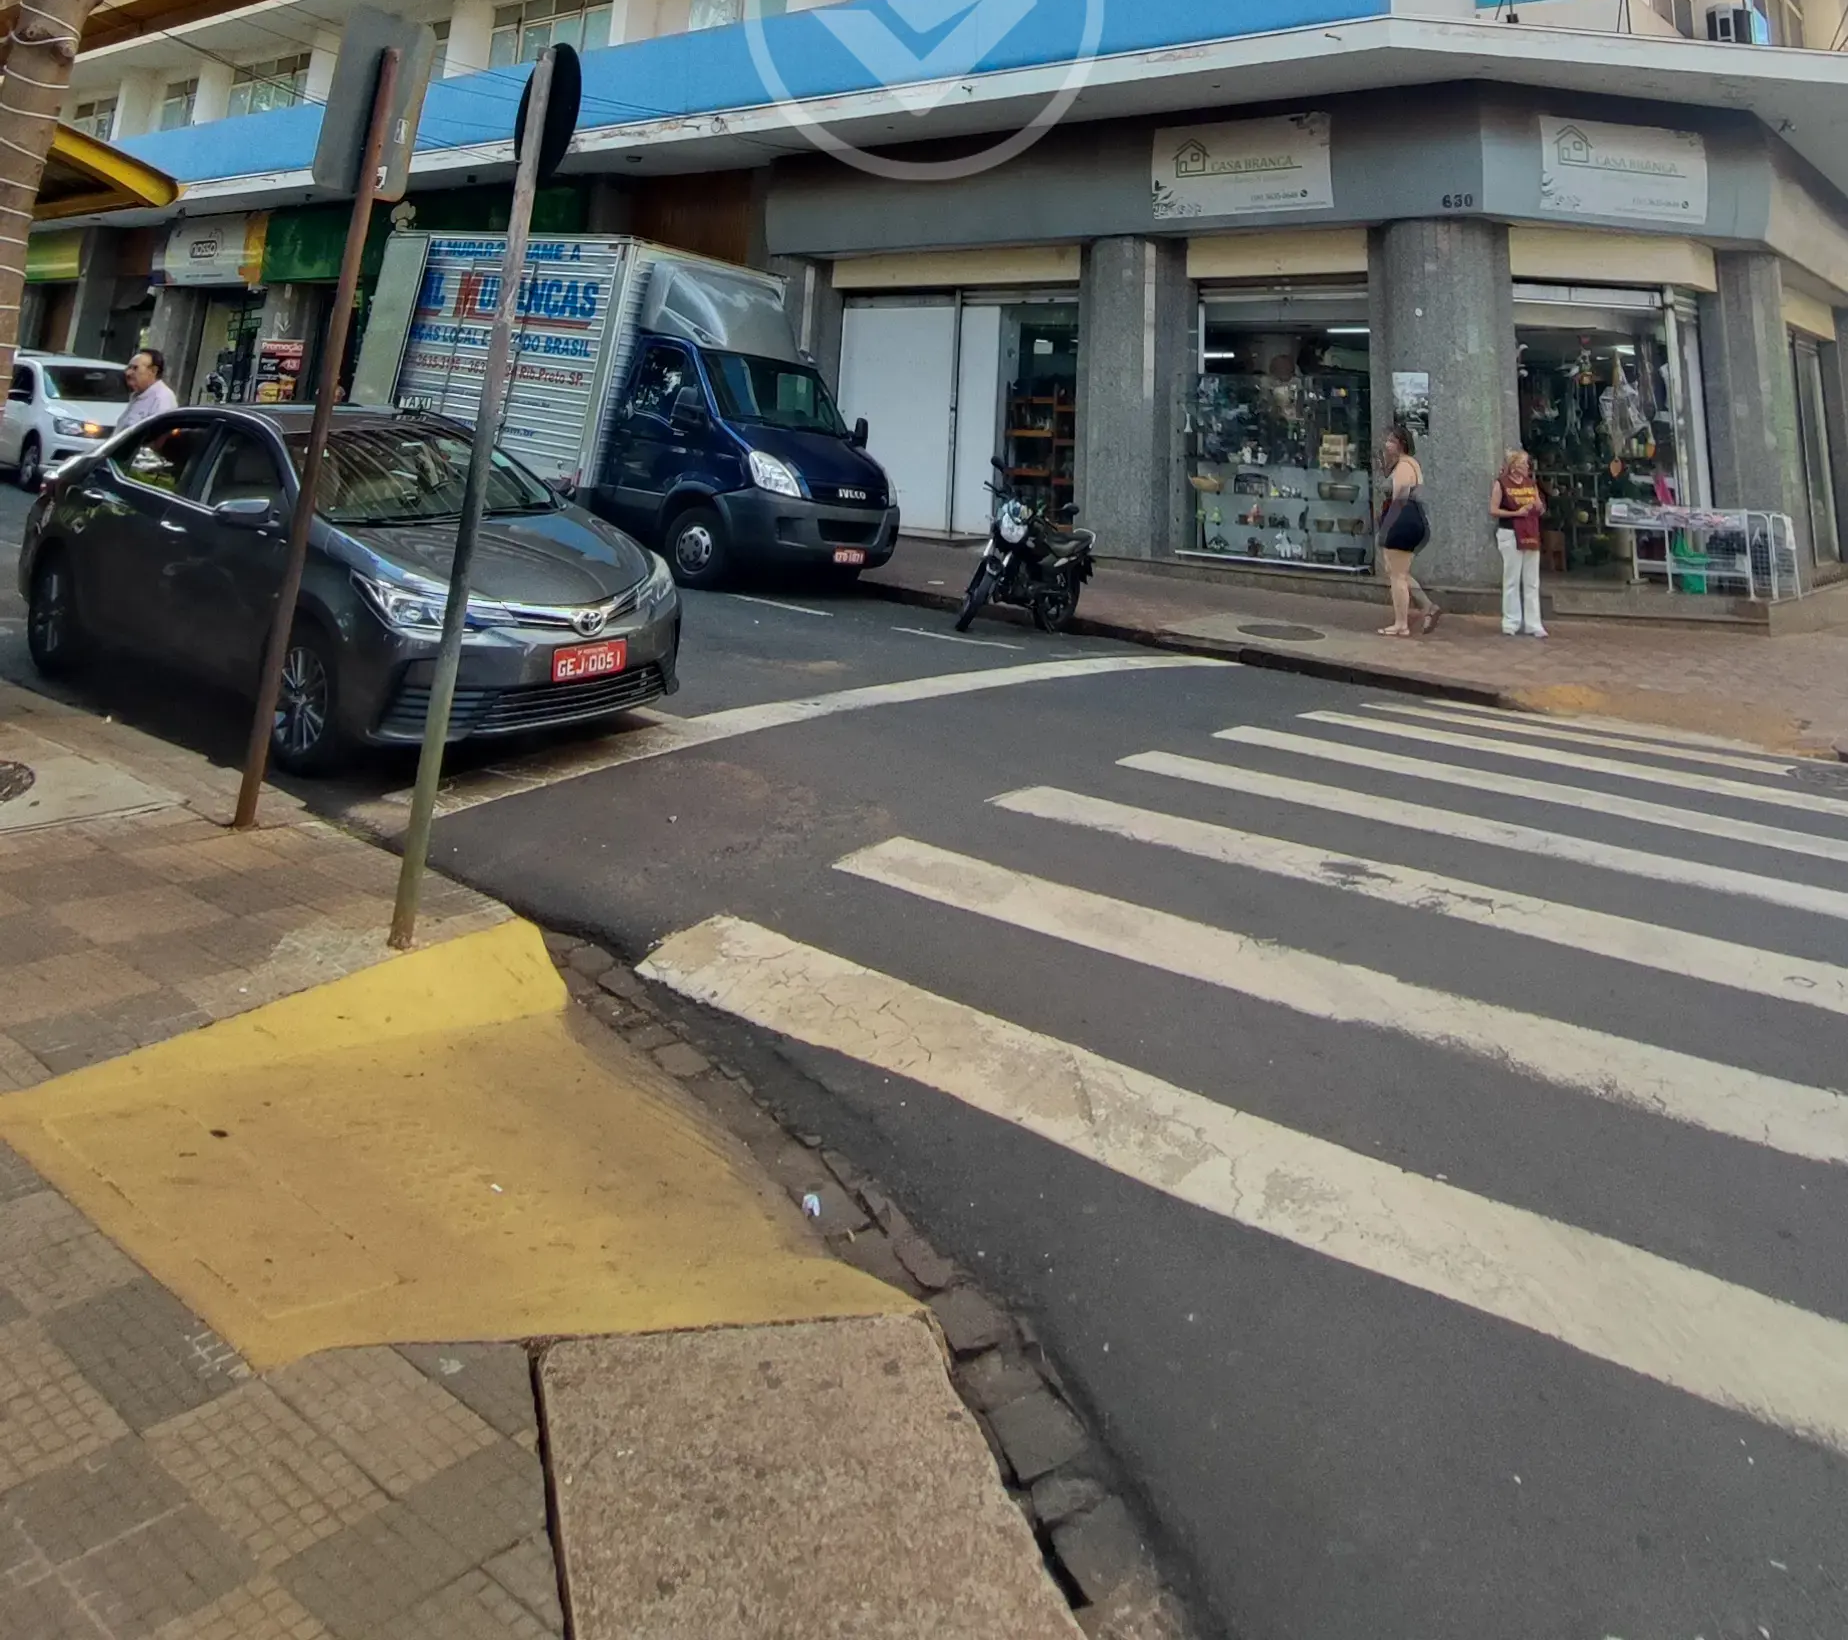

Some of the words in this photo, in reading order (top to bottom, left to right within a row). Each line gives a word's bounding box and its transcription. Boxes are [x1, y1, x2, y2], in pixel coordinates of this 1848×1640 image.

[1211, 159, 1242, 172] CASA
[1244, 155, 1294, 170] BRANCA
[1595, 156, 1627, 170] CASA
[1628, 159, 1678, 174] BRANCA
[526, 243, 565, 260] AME
[569, 244, 581, 261] A
[453, 271, 600, 318] MUNÇAS
[261, 342, 303, 353] Promoção
[544, 335, 591, 358] BRASIL
[839, 488, 867, 500] IVECO
